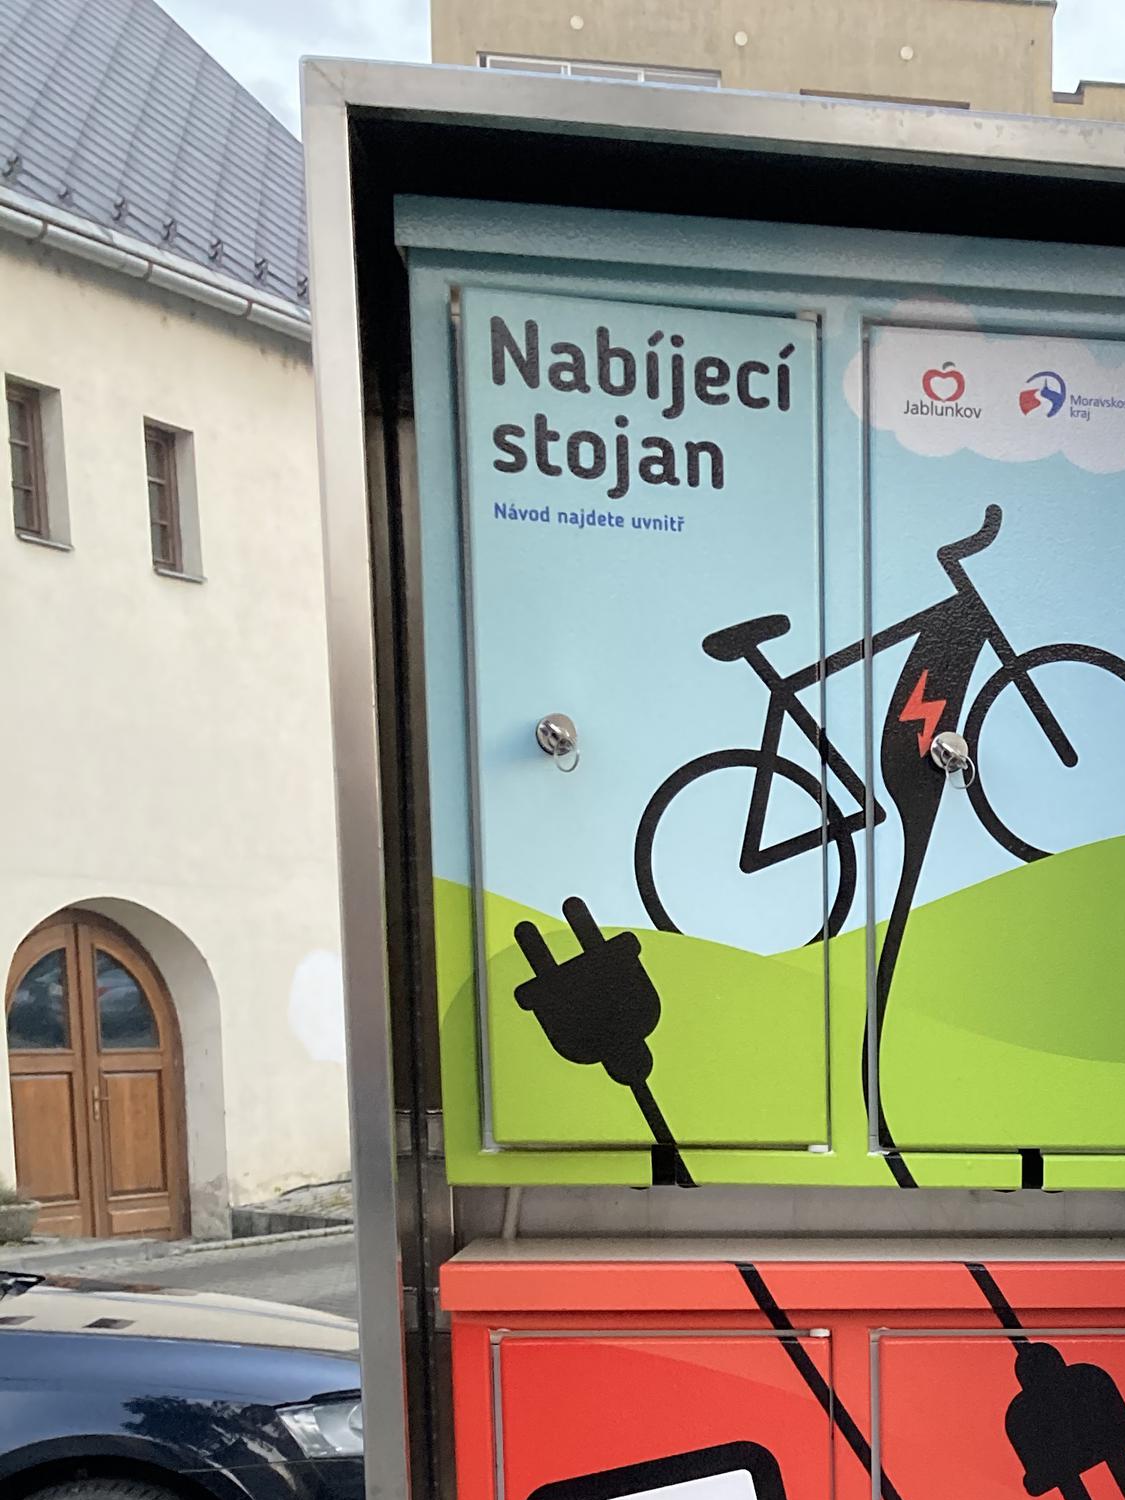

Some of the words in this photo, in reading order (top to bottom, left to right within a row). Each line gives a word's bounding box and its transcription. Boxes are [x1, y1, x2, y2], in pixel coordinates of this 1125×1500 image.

[490, 315, 796, 419] Nabíjecí
[904, 400, 982, 418] Jablunkov
[1070, 406, 1090, 422] kraj
[493, 413, 724, 499] stojan
[493, 502, 550, 523] Návod
[558, 508, 625, 530] najdete
[631, 514, 685, 532] uvnitř
